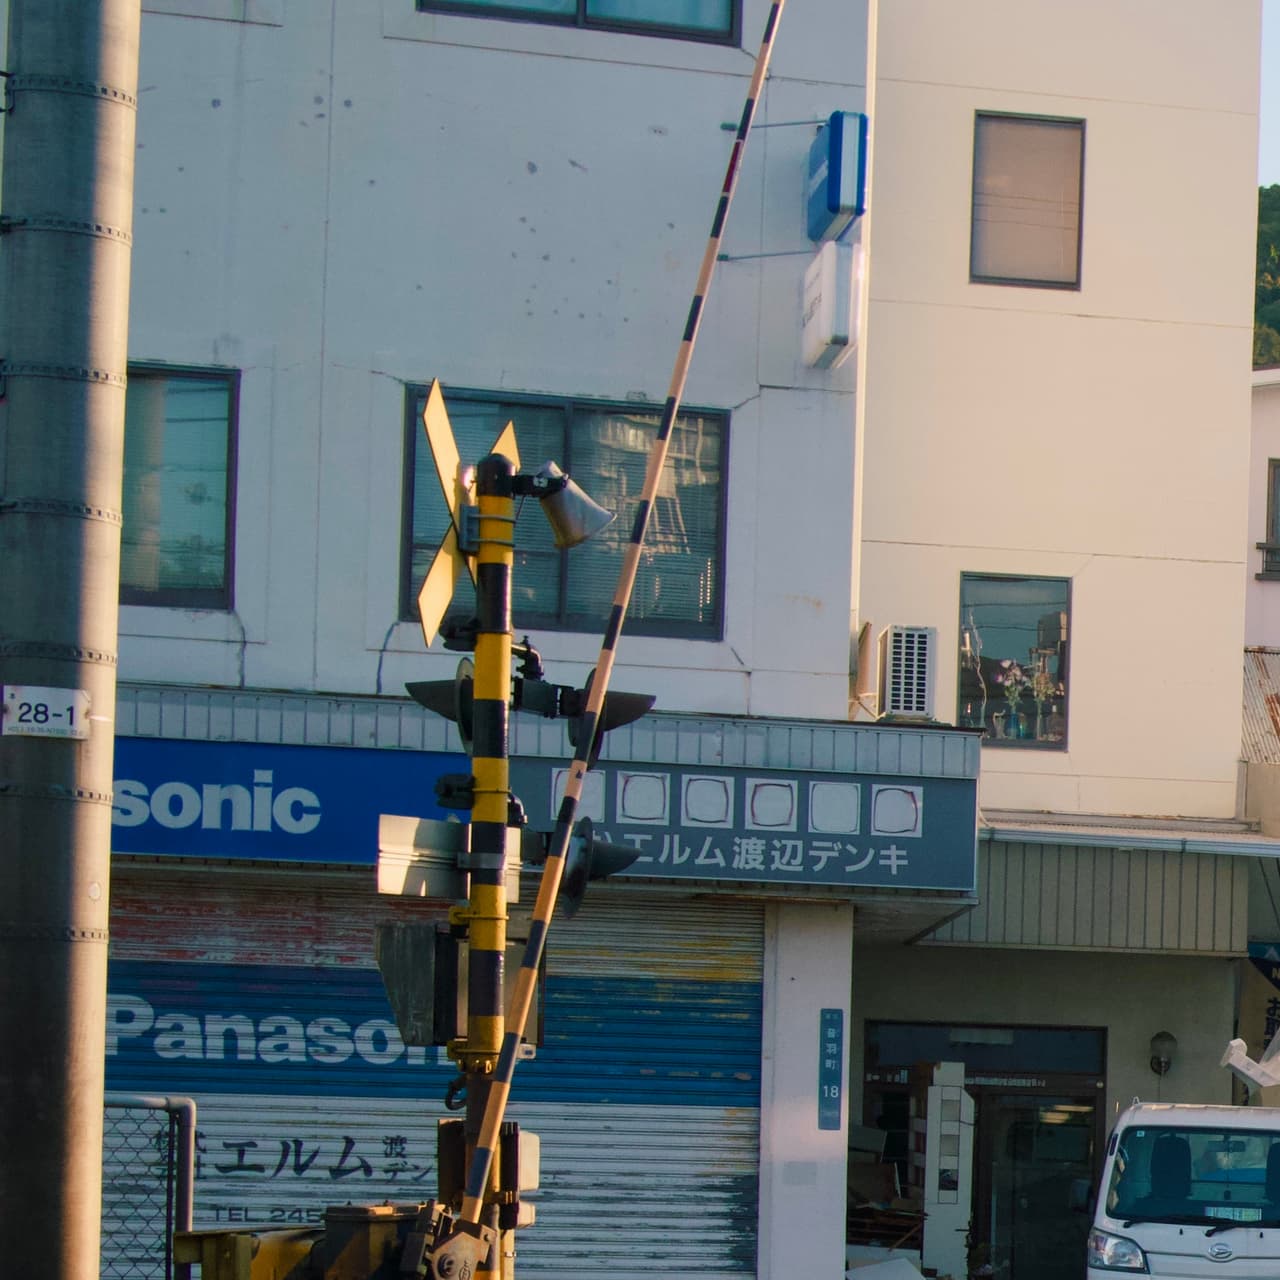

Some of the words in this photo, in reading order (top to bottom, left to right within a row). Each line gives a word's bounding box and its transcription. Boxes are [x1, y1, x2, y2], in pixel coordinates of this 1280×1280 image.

[18, 702, 75, 726] 28-1
[592, 829, 909, 875] エルム渡辺デンキ
[104, 993, 456, 1066] Panaso
[823, 1086, 839, 1098] 18
[215, 1135, 373, 1180] エルム
[208, 1206, 265, 1222] TEL
